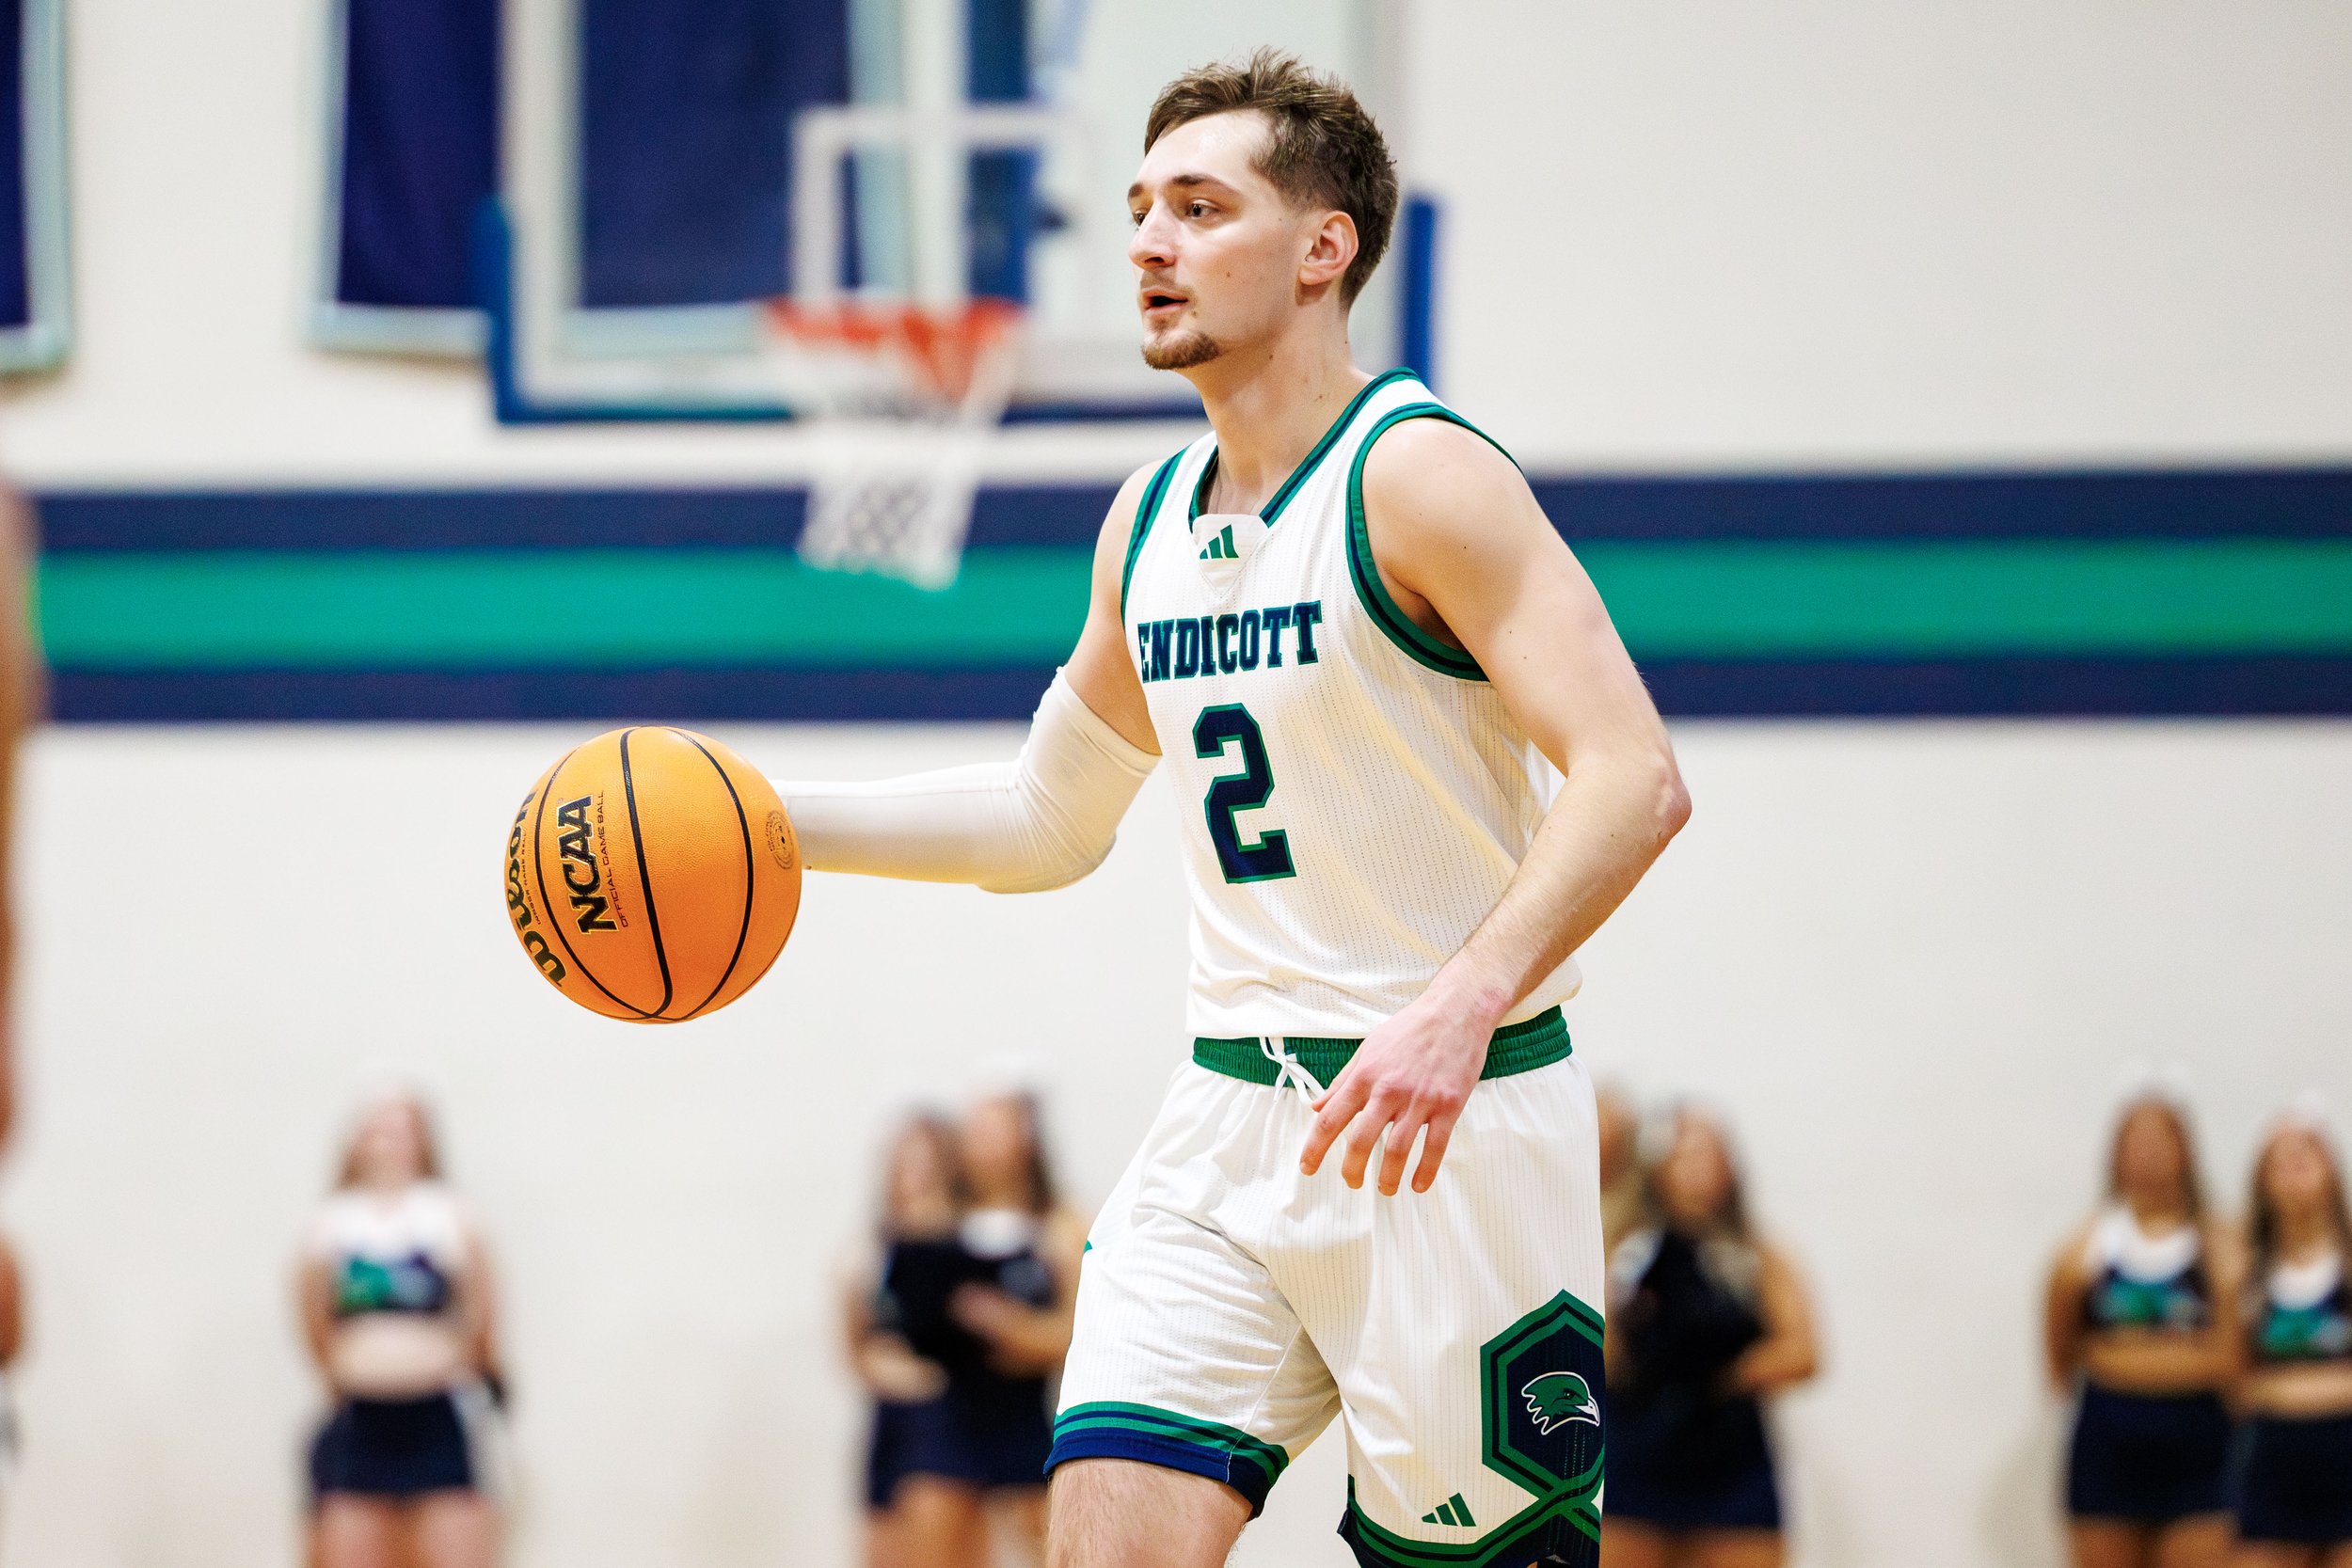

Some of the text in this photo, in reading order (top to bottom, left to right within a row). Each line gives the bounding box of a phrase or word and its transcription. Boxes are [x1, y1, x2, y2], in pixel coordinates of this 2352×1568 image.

[1137, 600, 1323, 684] ENDICOTT
[597, 826, 610, 865] GAME
[1192, 703, 1296, 884] 2
[508, 789, 567, 988] Wilson
[557, 794, 619, 934] NCAA
[607, 868, 628, 928] OFFICIAL
